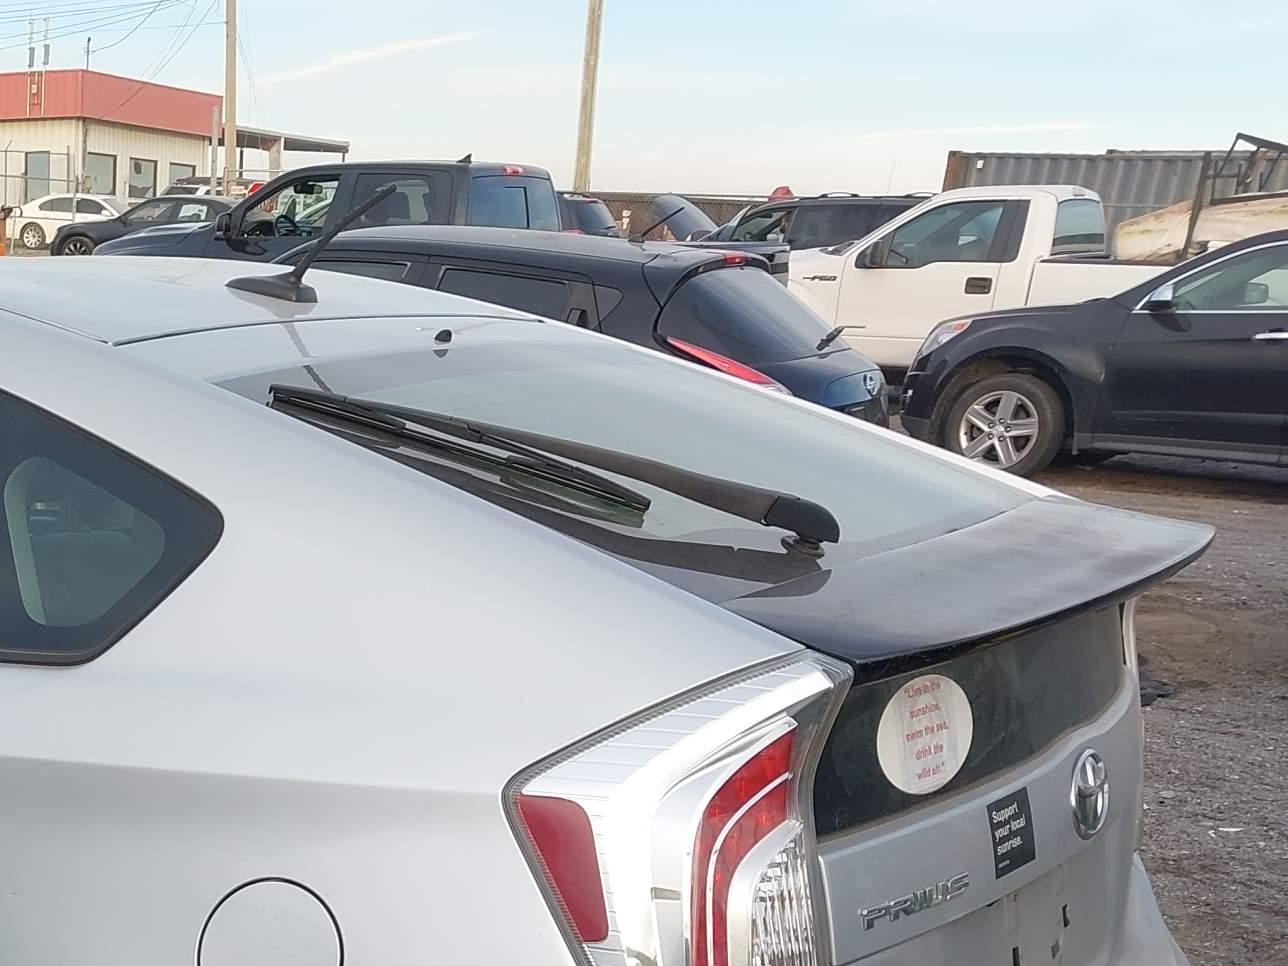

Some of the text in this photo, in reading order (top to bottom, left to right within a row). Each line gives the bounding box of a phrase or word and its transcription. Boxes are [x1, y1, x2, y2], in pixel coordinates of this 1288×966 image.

[924, 724, 935, 736] the
[916, 742, 944, 760] drink the
[917, 766, 931, 780] wild
[991, 801, 1019, 824] Support
[994, 813, 1027, 842] your local
[997, 835, 1024, 856] sunrise.
[858, 872, 970, 931] PRIUS
